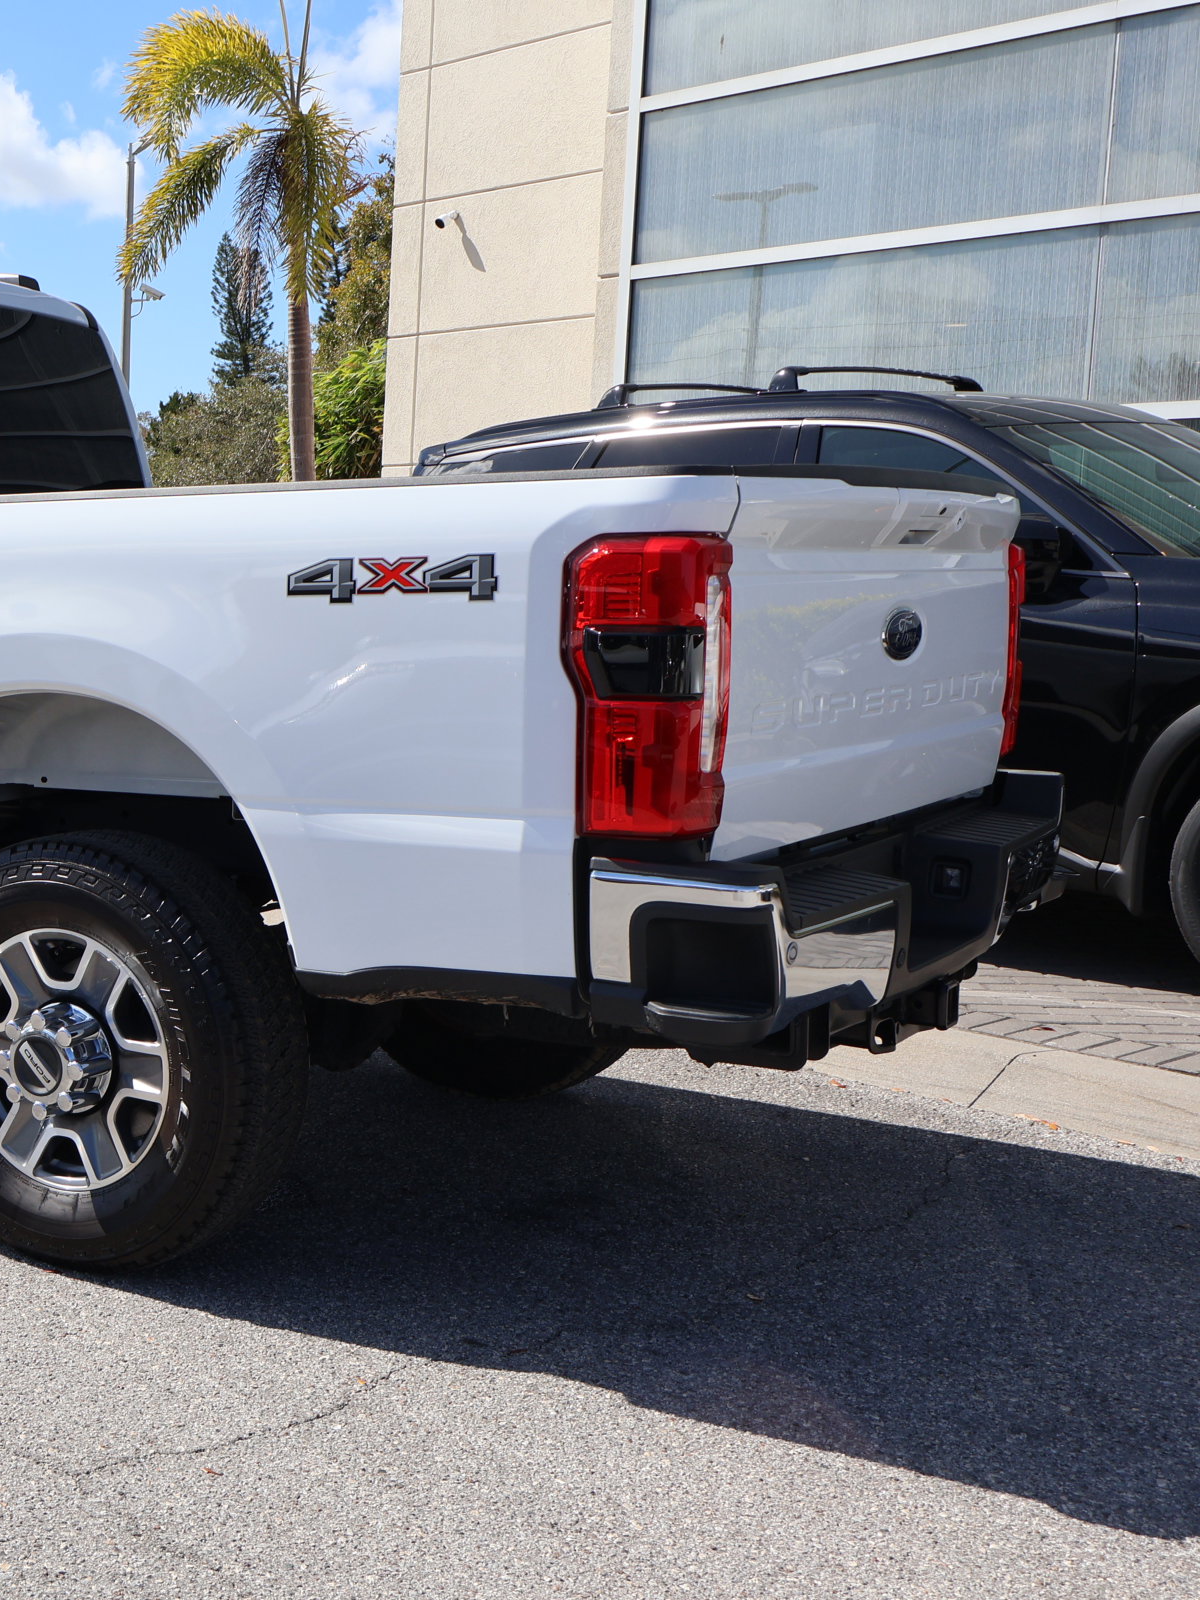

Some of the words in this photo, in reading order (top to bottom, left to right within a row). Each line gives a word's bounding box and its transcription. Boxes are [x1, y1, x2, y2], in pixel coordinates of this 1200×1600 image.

[751, 687, 912, 735] SUPER
[921, 669, 1004, 707] DUTY
[24, 1048, 51, 1084] FORD
